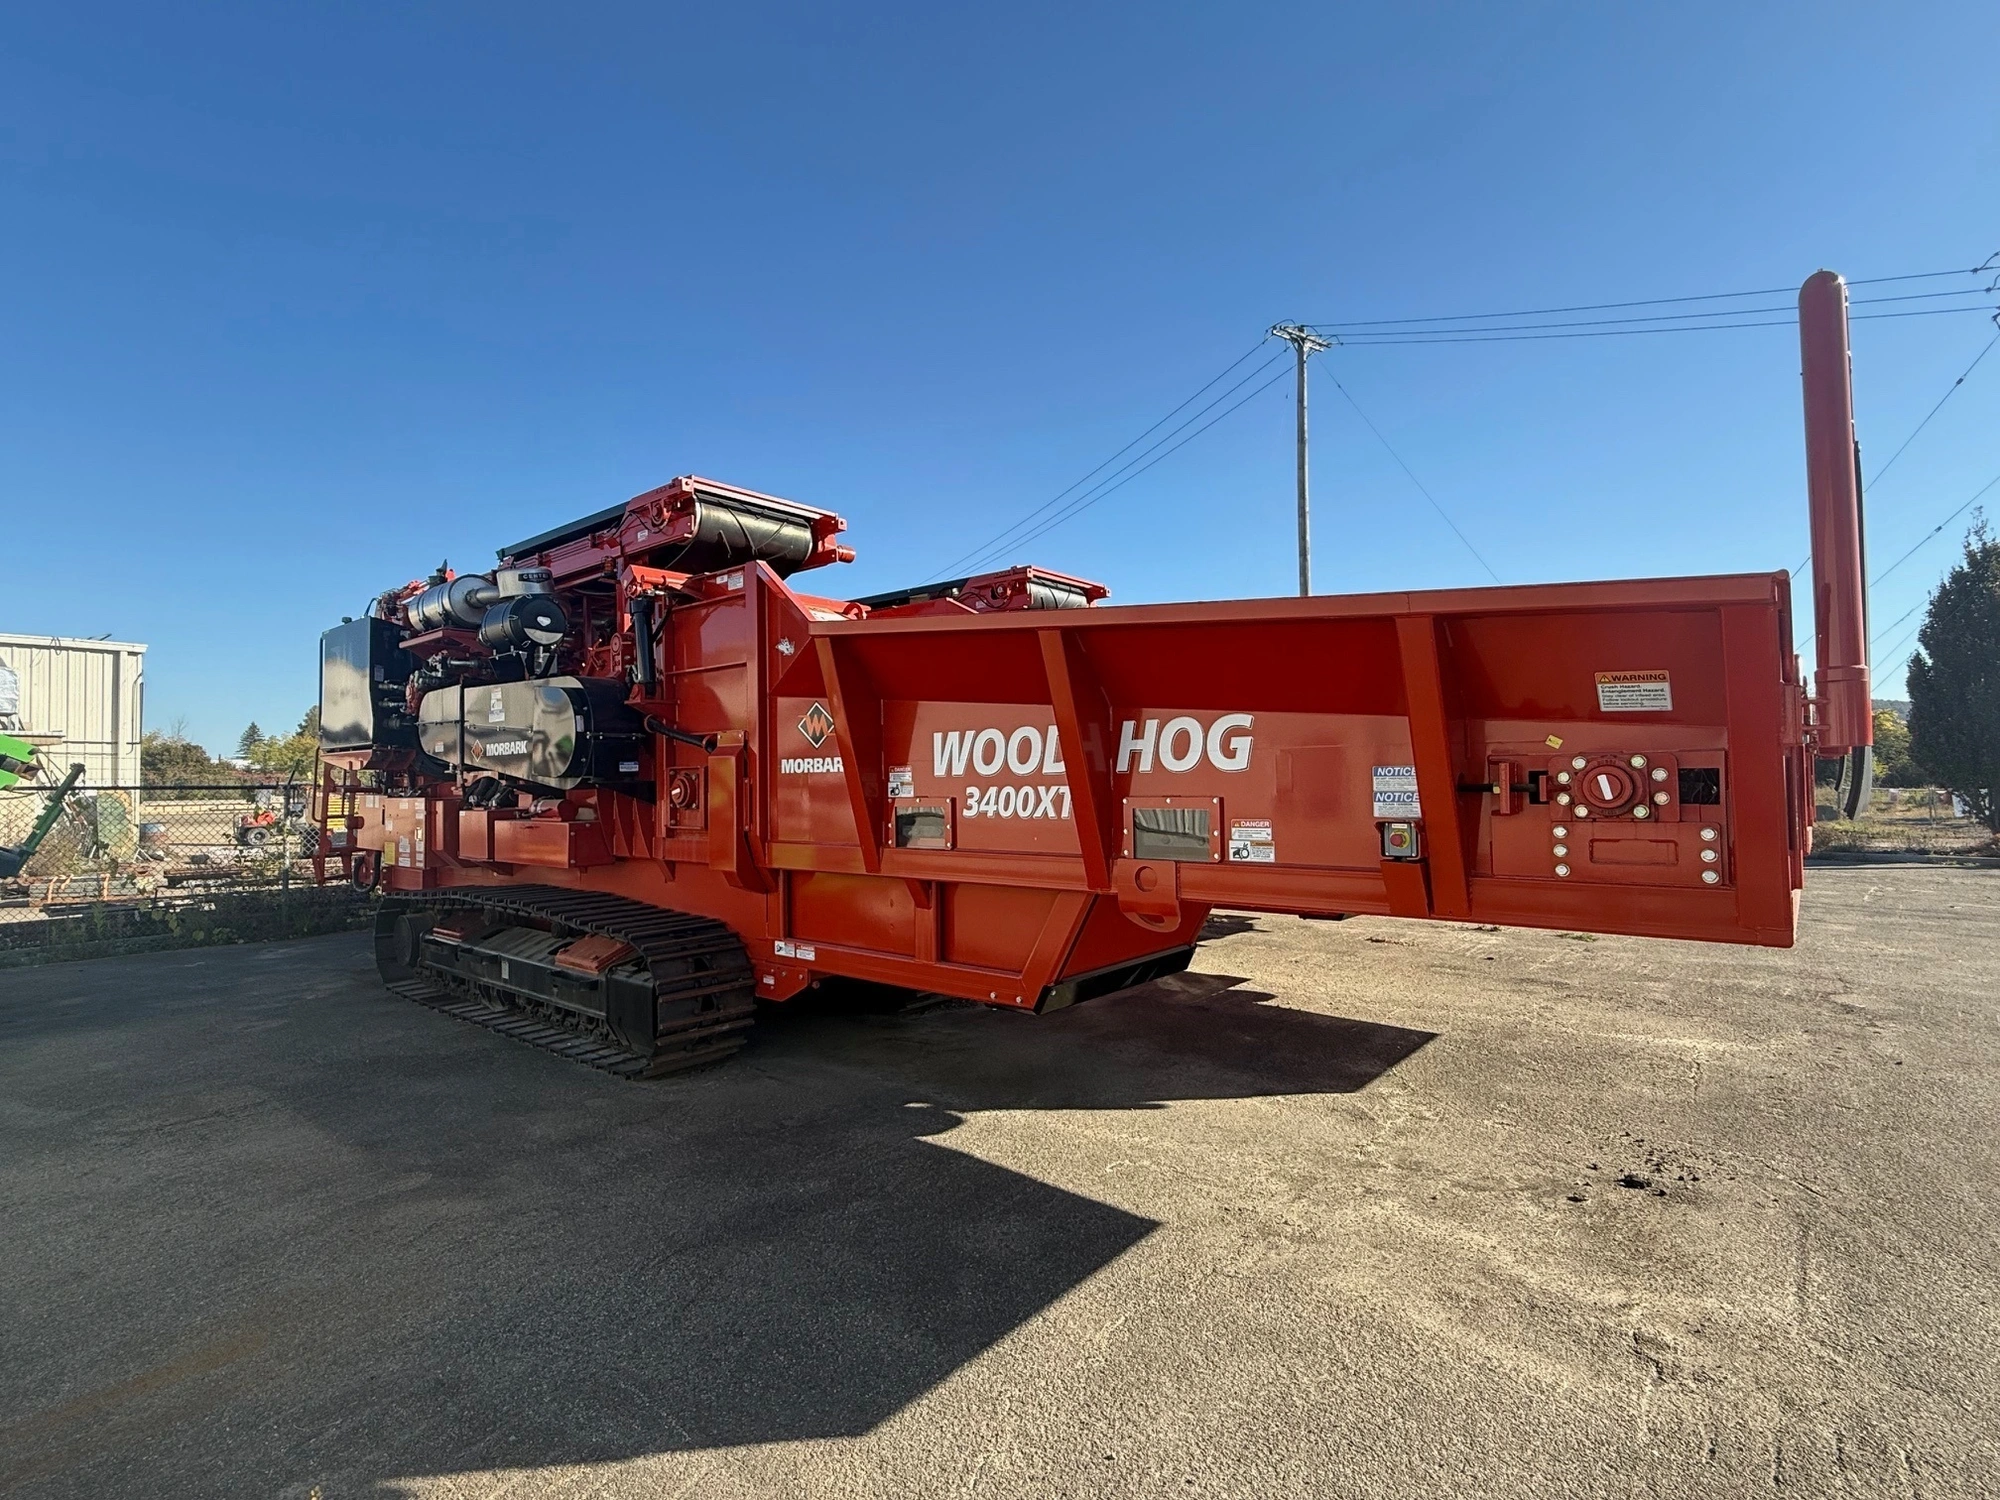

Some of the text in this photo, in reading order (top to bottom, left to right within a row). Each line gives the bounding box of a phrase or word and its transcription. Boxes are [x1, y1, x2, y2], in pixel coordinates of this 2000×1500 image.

[1611, 673, 1667, 682] WARNING
[486, 741, 528, 757] MORBARK
[1116, 713, 1254, 774] HOG
[781, 757, 844, 774] MORBAR
[1377, 767, 1417, 776] NOTICE
[962, 785, 1072, 820] 3400XT
[1375, 792, 1420, 802] NOTICE
